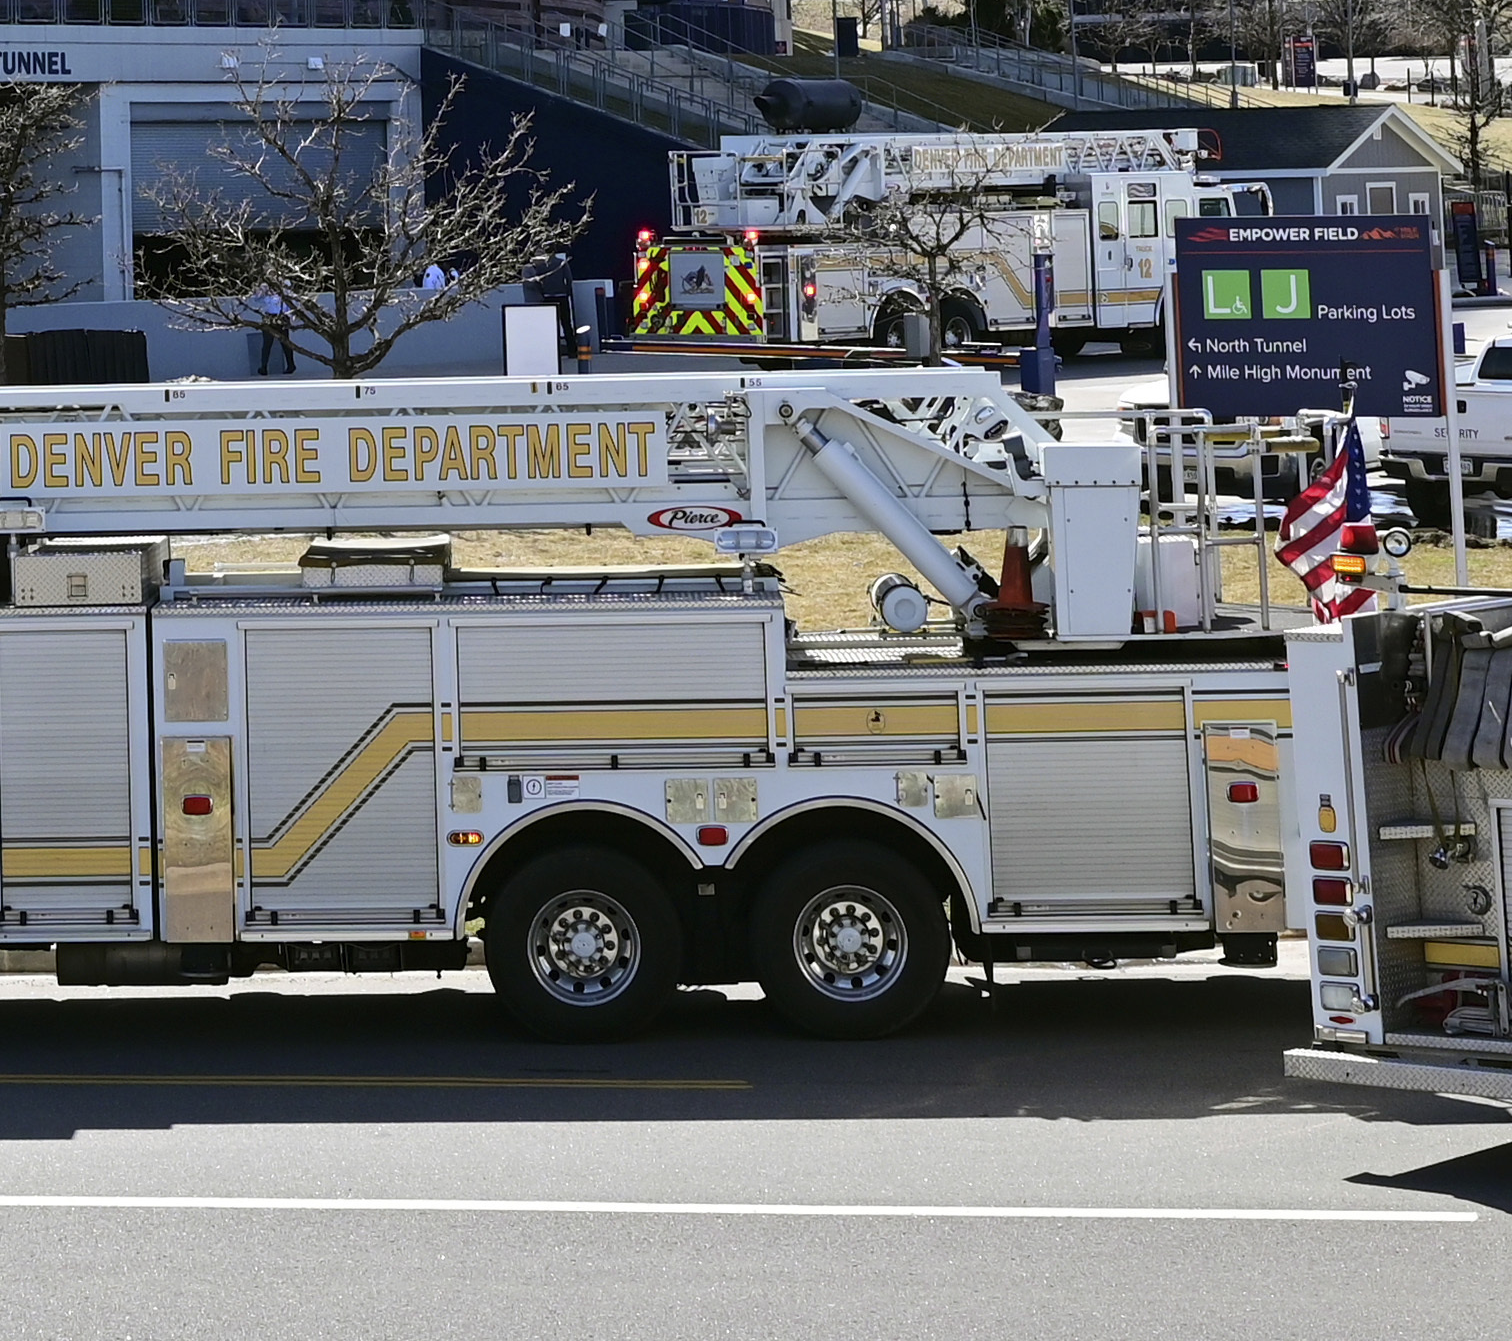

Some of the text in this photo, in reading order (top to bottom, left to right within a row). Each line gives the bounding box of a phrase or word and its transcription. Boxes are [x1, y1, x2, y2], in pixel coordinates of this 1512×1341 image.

[994, 146, 1063, 167] DEPARTMENT
[694, 209, 707, 225] 12
[1229, 227, 1359, 242] EMPOWER FIELD
[1139, 258, 1152, 278] 12
[1207, 275, 1298, 314] L J
[1318, 305, 1415, 322] Parking Lots
[1206, 338, 1306, 352] North Tunnel
[1208, 365, 1239, 379] Mile
[1245, 365, 1281, 383] High
[173, 390, 185, 399] 85
[364, 386, 376, 395] 75
[556, 382, 569, 391] 65
[749, 378, 762, 387] 55
[1403, 395, 1433, 404] NOTICE
[1434, 427, 1479, 440] SERITY
[10, 422, 655, 489] DENVER FIRE DEPARTMENT
[668, 508, 721, 526] Pierce
